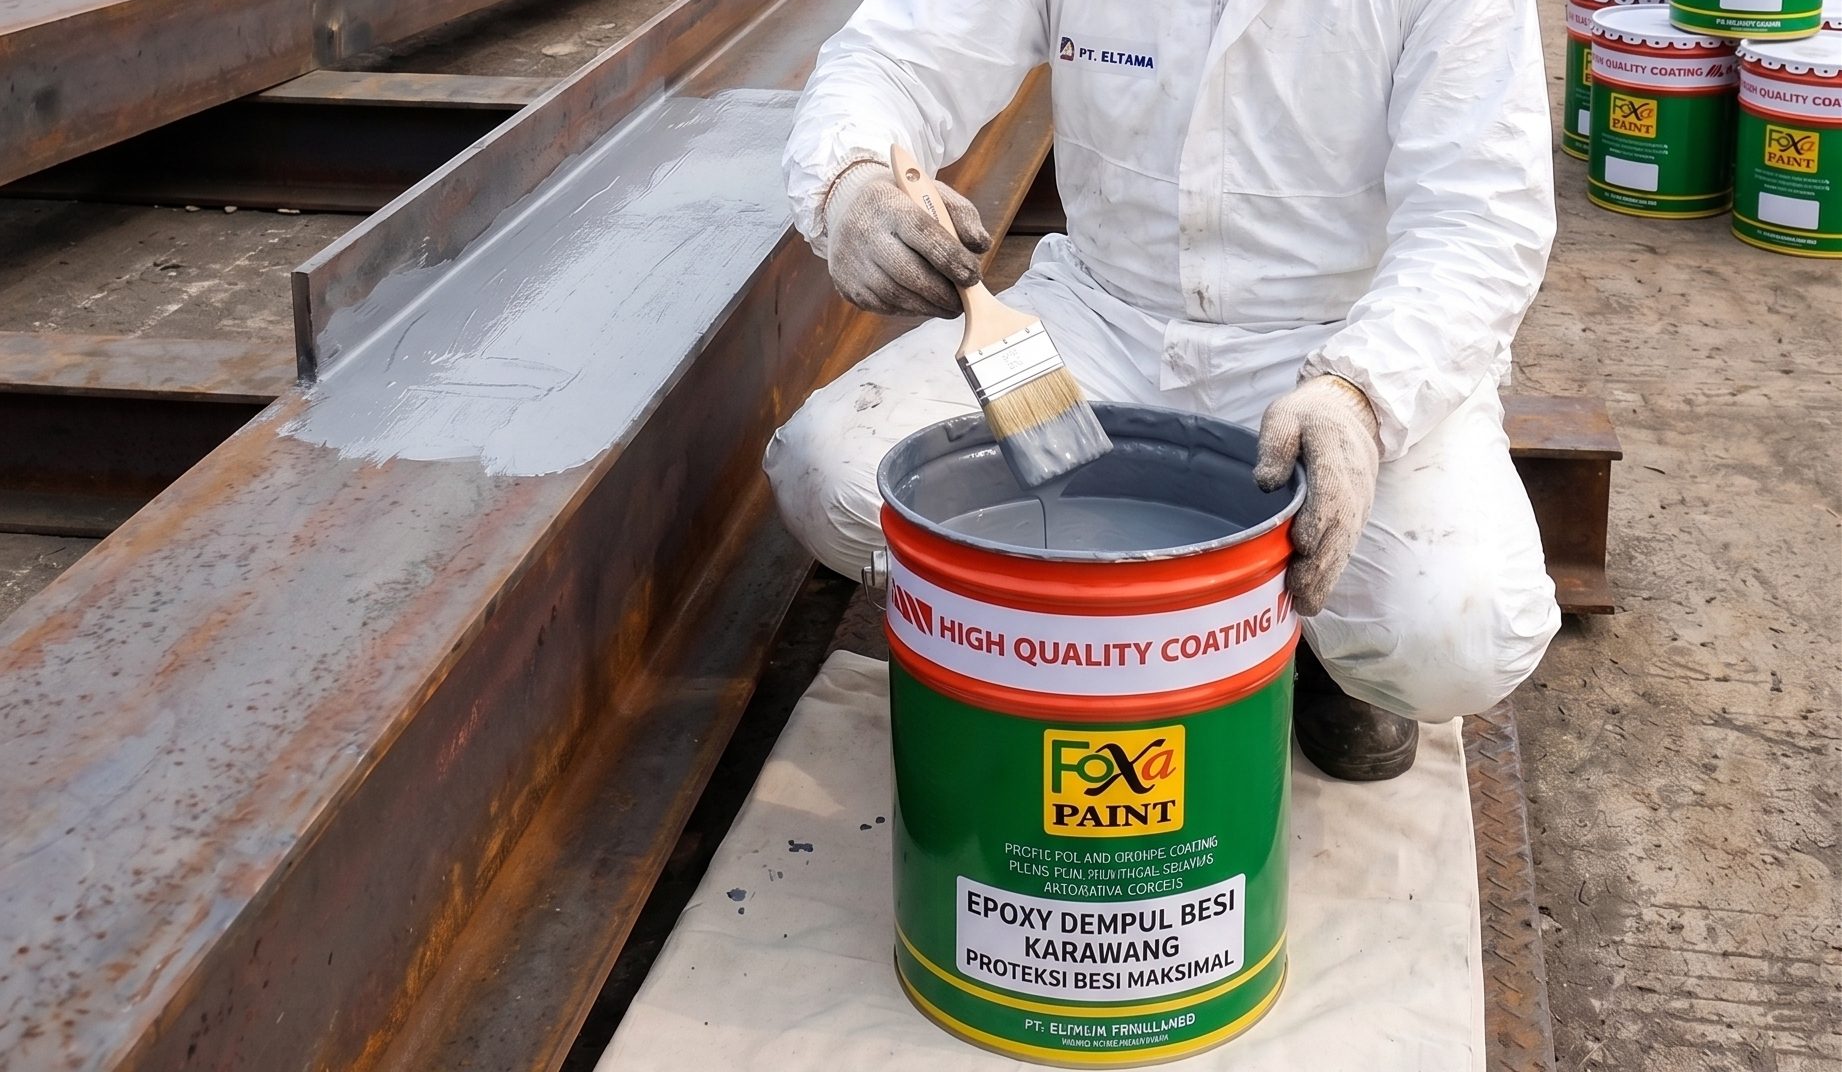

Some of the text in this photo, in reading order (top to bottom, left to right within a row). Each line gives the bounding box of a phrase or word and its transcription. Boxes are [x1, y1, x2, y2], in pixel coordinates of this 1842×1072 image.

[1079, 47, 1154, 69] PT. ELTAMA
[1605, 58, 1647, 74] QUALITY
[1650, 66, 1704, 77] COATING
[1759, 88, 1808, 104] QUALITY
[1612, 117, 1653, 134] PAINT
[939, 607, 1271, 667] HIGH QUALITY COATING
[1052, 799, 1176, 828] PAINT
[1084, 852, 1111, 864] AND
[967, 889, 1235, 935] EPOXY DEMPUL BESI
[1024, 935, 1180, 964] KARAWANG
[966, 947, 1234, 990] PROTEKSI BESI MAKSIMAL
